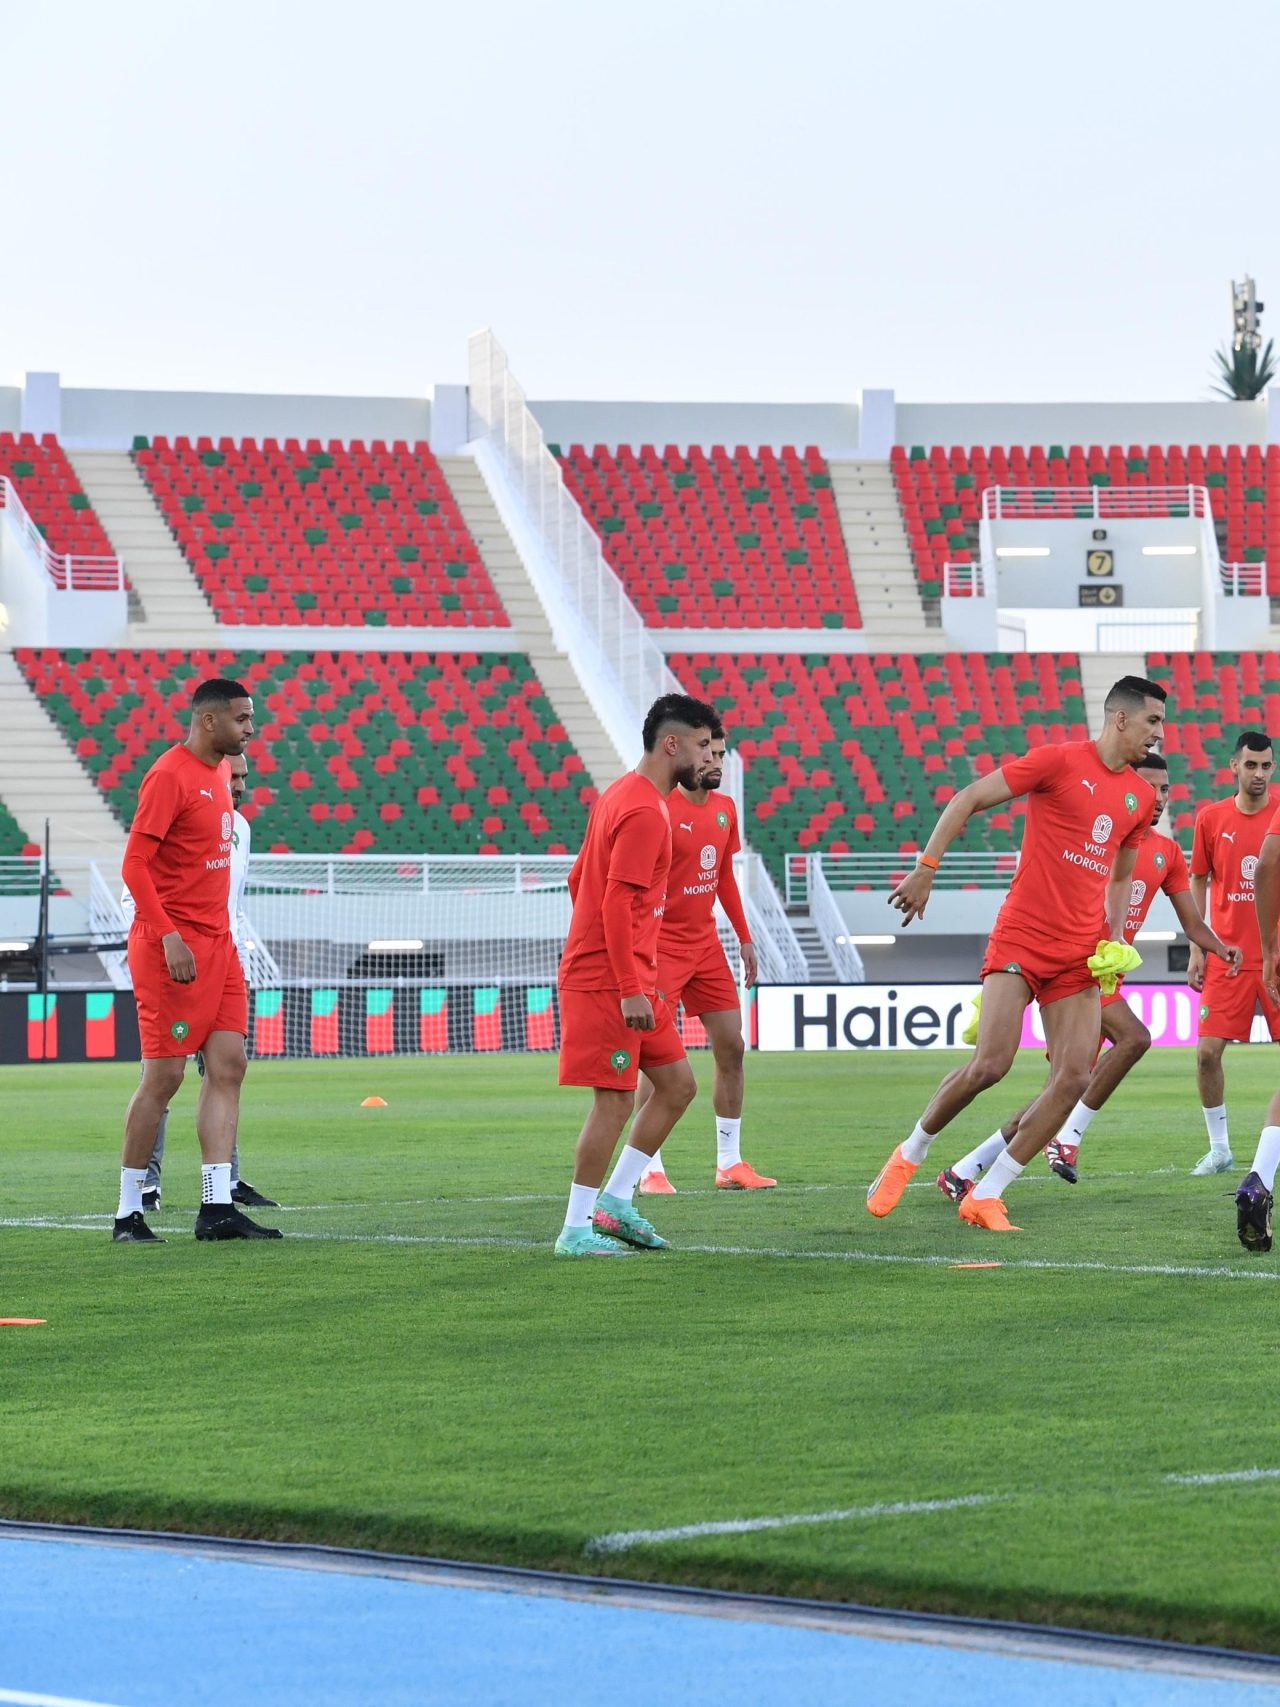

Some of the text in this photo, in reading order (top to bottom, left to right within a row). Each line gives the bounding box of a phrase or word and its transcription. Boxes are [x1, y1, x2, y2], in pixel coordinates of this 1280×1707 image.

[1095, 555, 1106, 571] 7
[1084, 842, 1107, 858] VISIT
[1062, 849, 1109, 876] MOROCCO
[698, 870, 717, 881] VISIT
[793, 990, 963, 1049] Haier
